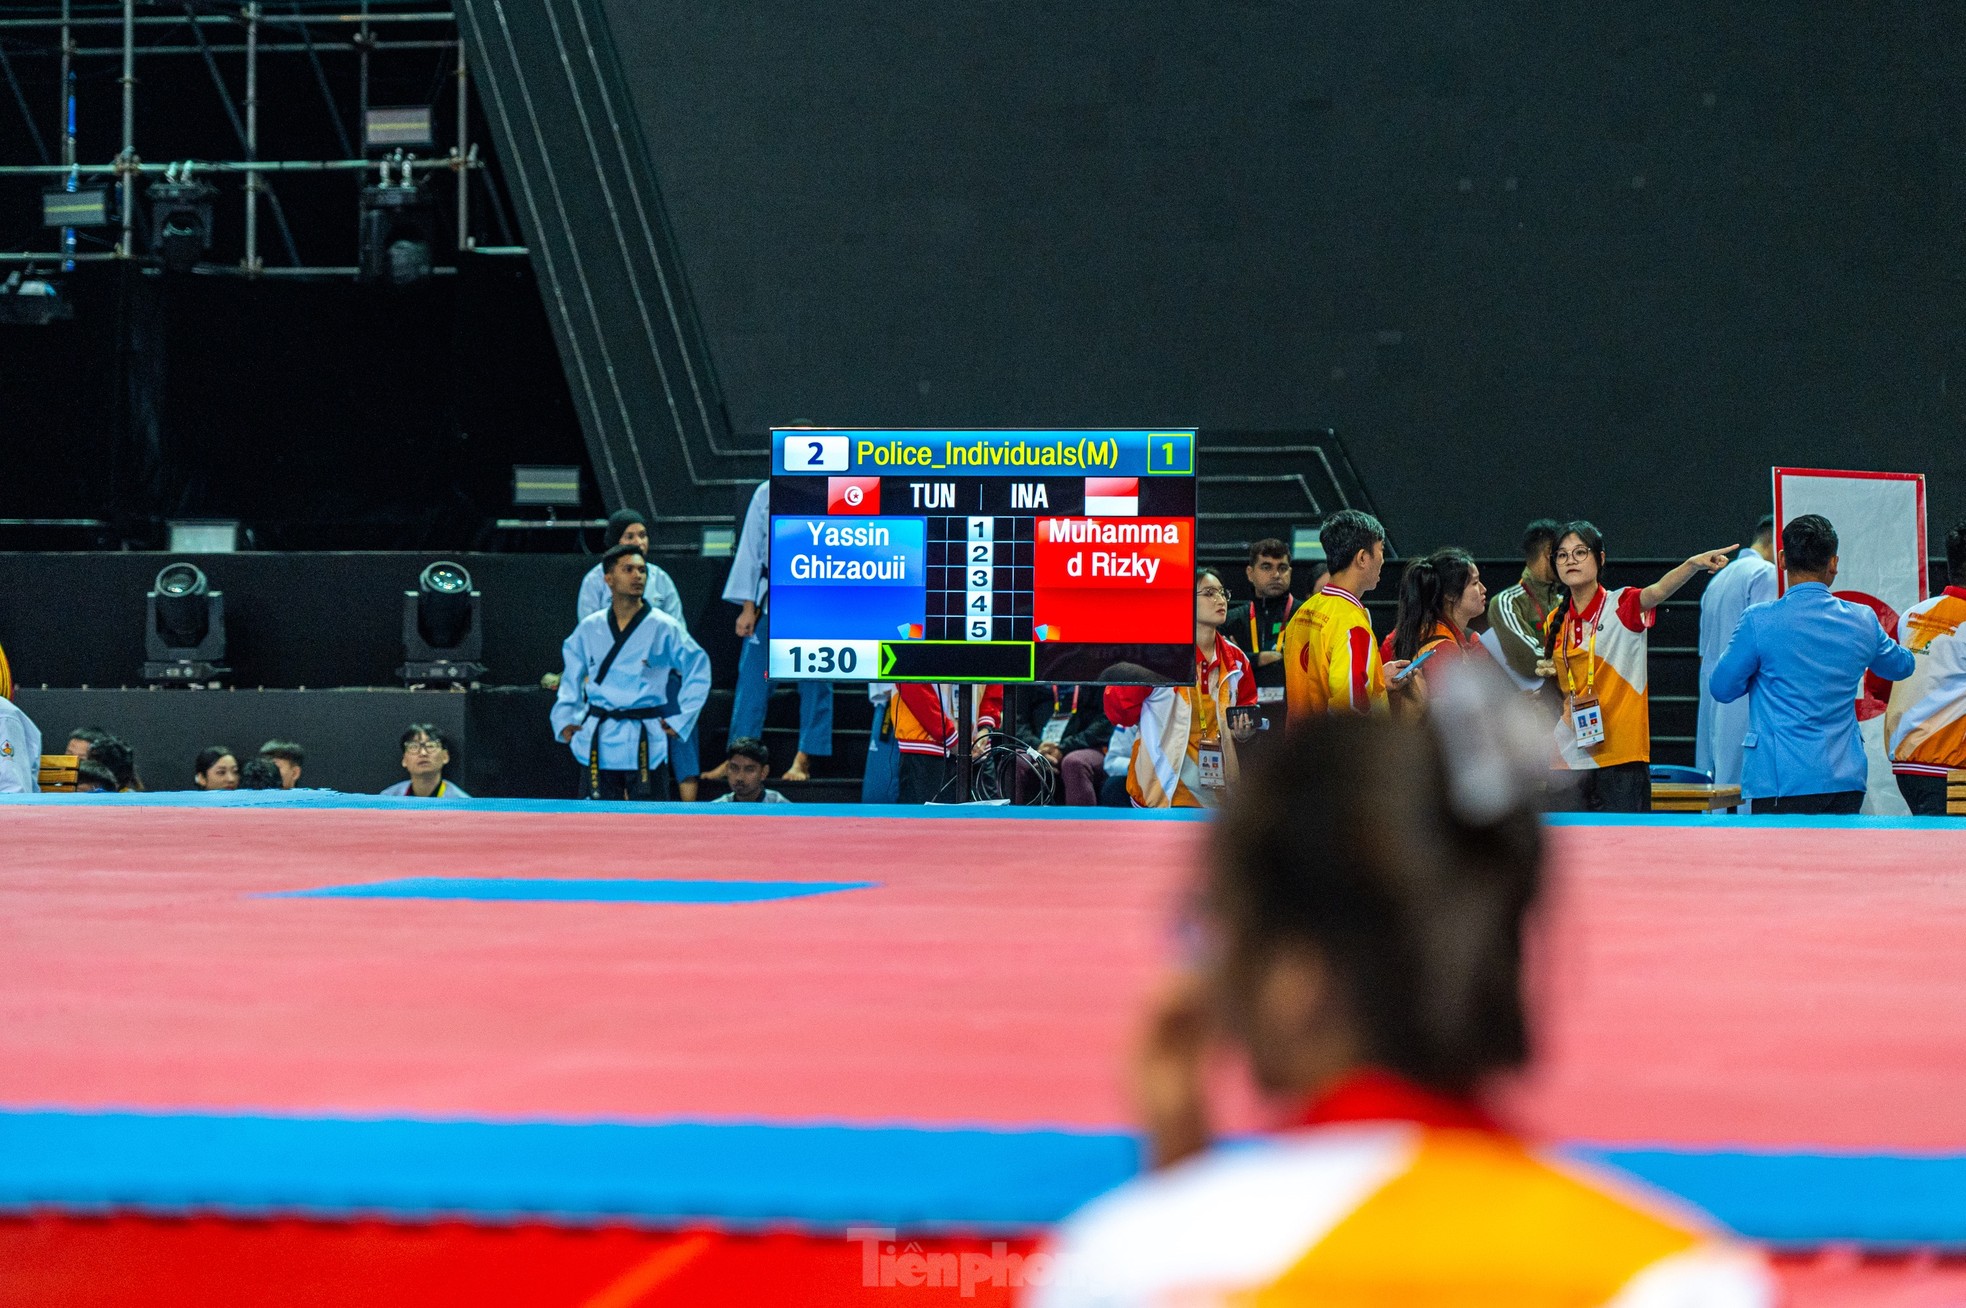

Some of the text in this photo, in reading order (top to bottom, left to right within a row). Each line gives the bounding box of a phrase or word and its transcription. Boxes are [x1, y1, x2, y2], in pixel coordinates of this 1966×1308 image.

[807, 442, 824, 465] 2
[857, 440, 1118, 468] Police_Individuals(M)
[1161, 442, 1173, 465] 1
[910, 483, 955, 508] TUN
[1011, 483, 1049, 508] INA
[807, 522, 890, 546] Yassin
[973, 521, 984, 538] 1
[1048, 519, 1179, 544] Muhamma
[972, 545, 988, 562] 2
[790, 554, 906, 580] Ghizaouii
[972, 570, 988, 587] 3
[1067, 552, 1160, 583] d Rizky
[971, 595, 988, 612] 4
[971, 621, 987, 638] 5
[789, 647, 857, 673] 1:30
